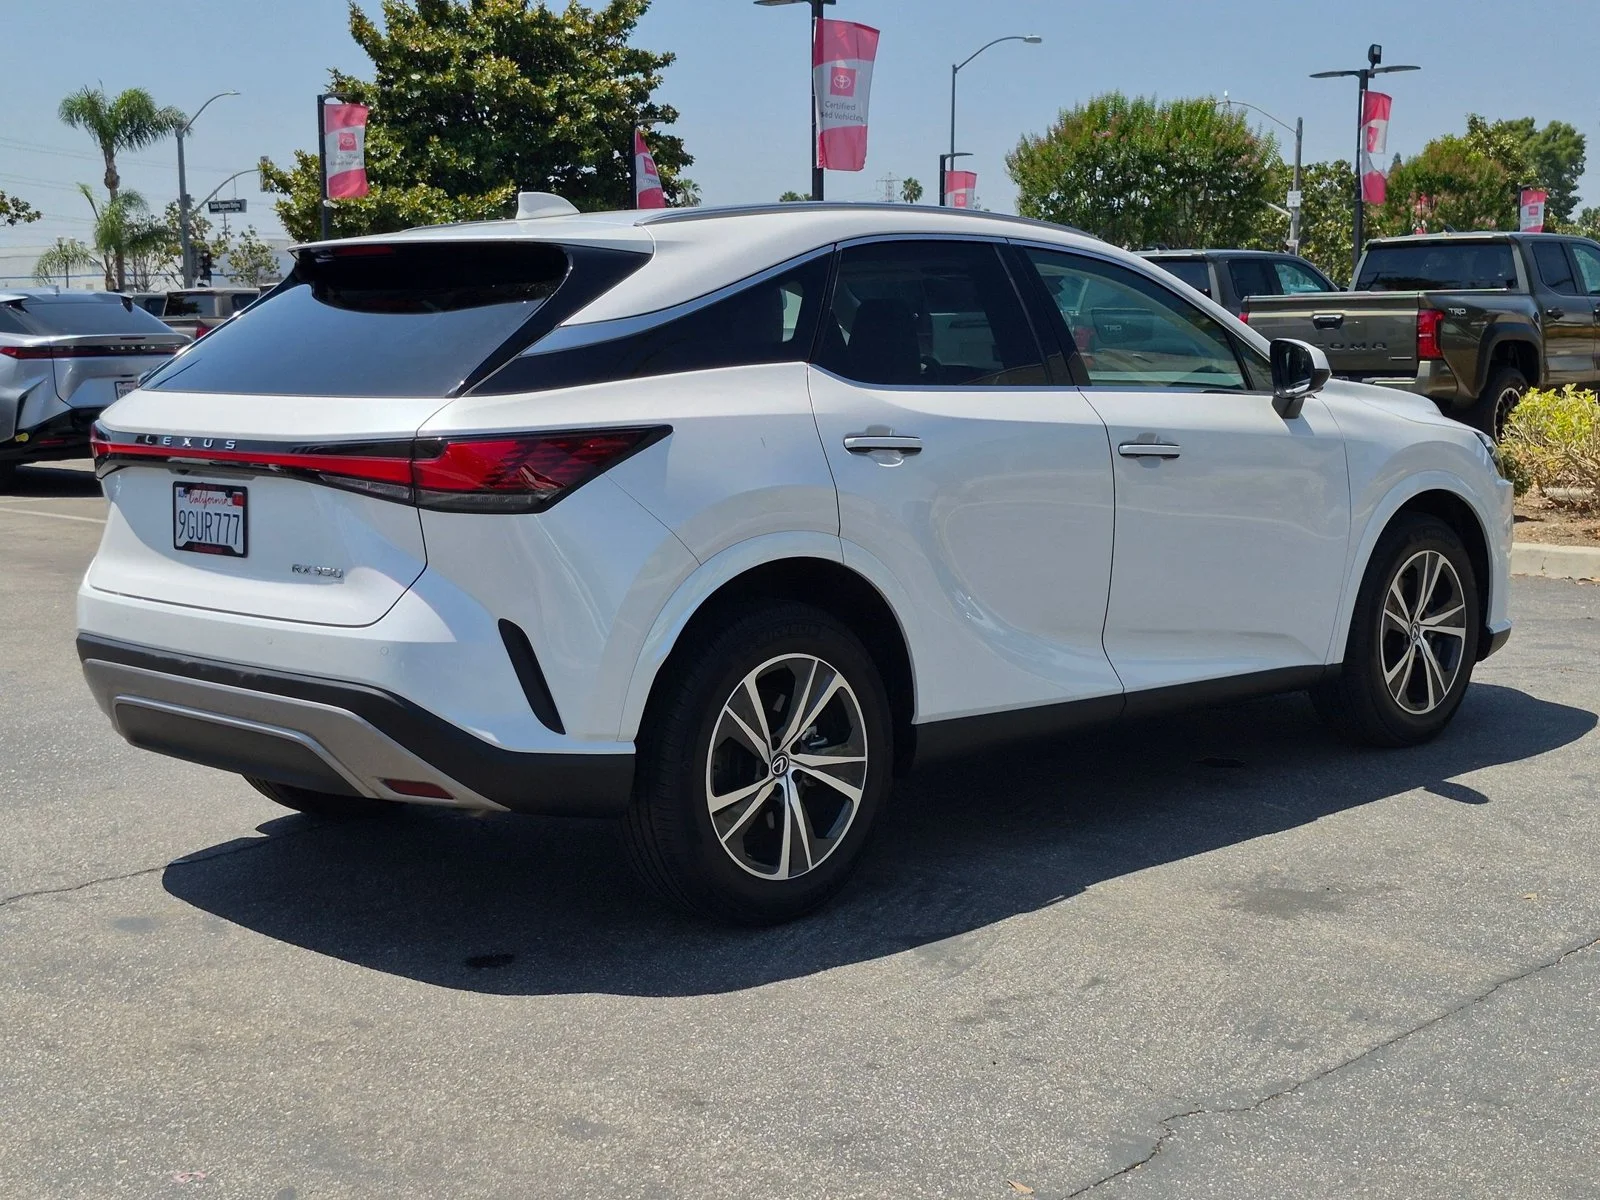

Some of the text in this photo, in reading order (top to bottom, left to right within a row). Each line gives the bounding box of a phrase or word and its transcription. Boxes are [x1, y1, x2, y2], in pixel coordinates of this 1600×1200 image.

[824, 100, 857, 111] Certified
[834, 112, 864, 123] Vehicles
[1448, 307, 1467, 316] TRD
[145, 434, 236, 450] LEXUS
[189, 489, 228, 510] California
[178, 509, 240, 545] 9GUR777
